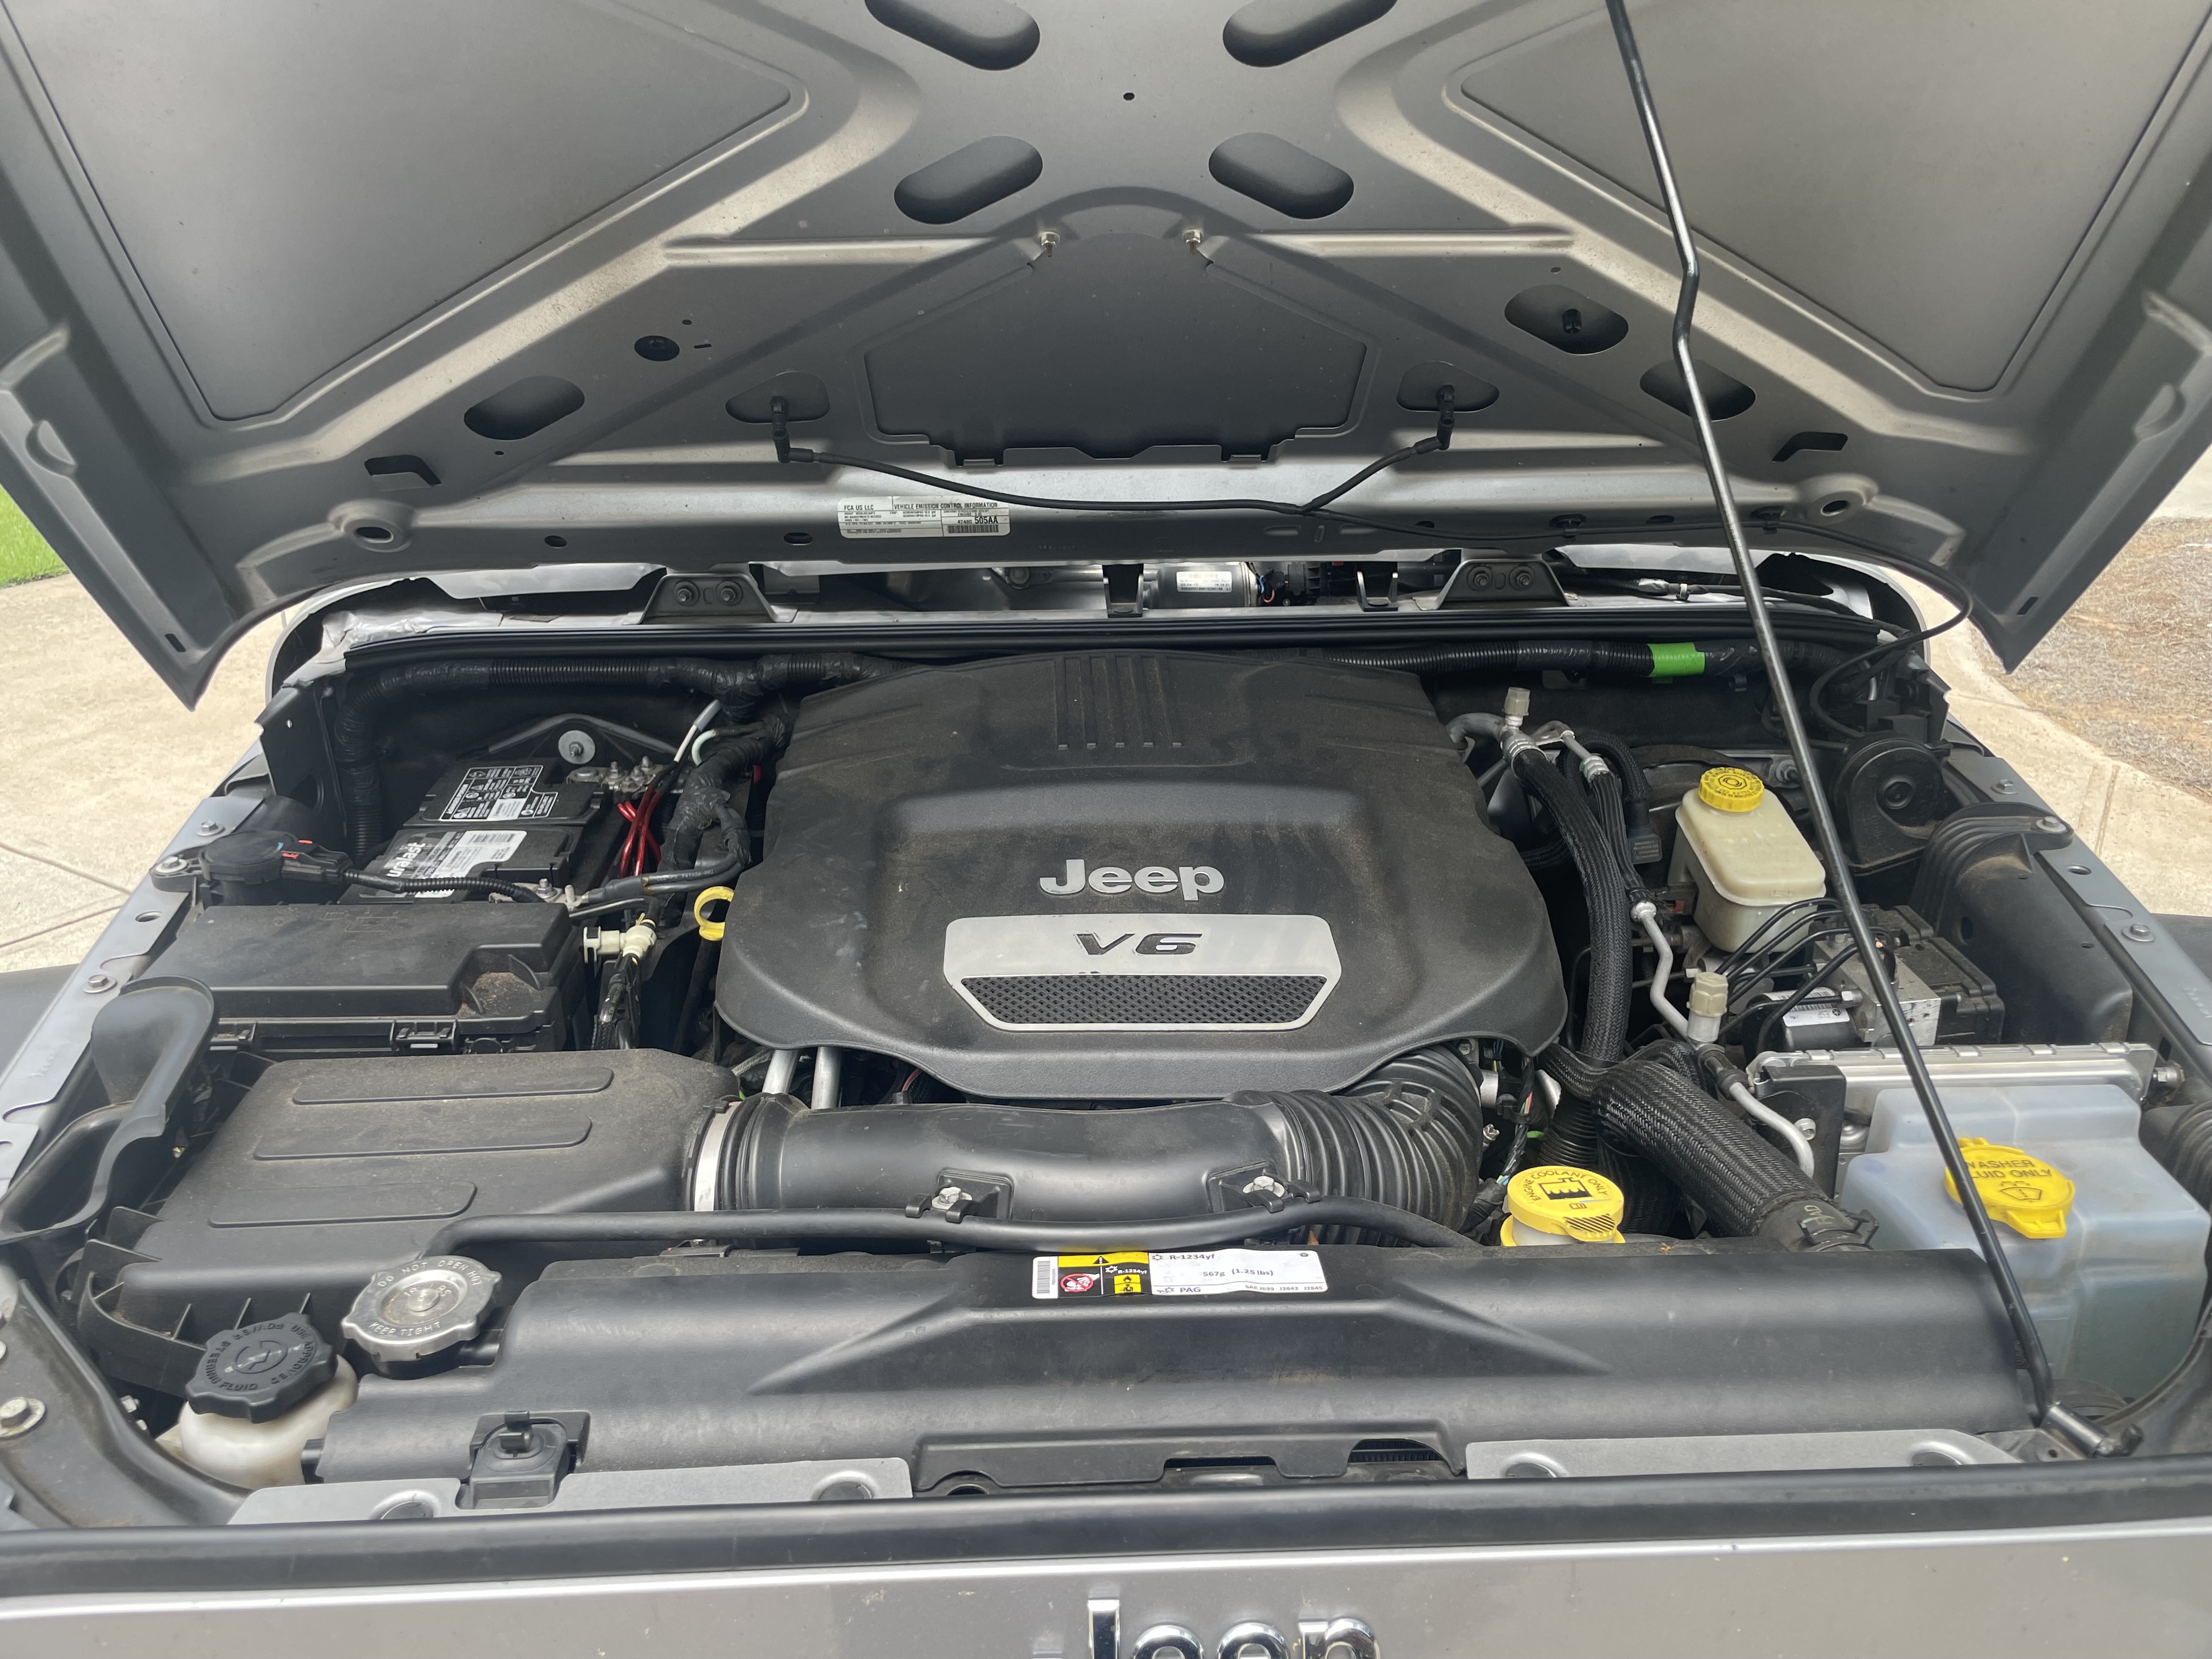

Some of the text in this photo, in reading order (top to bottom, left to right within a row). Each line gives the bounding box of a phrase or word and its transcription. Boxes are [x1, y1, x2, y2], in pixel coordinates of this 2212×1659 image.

[386, 842, 426, 877] uralast
[1040, 859, 1225, 901] Jeep
[1075, 933, 1203, 956] V6
[1522, 1170, 1609, 1201] ENGINE COOLANT ONLY
[1972, 1169, 2052, 1178] UID ONLY
[377, 1260, 483, 1288] DO NOT OPEN HOT
[368, 1321, 442, 1336] KEEP TIGHT
[206, 1340, 232, 1384] STEERING
[219, 1381, 258, 1391] FLUID
